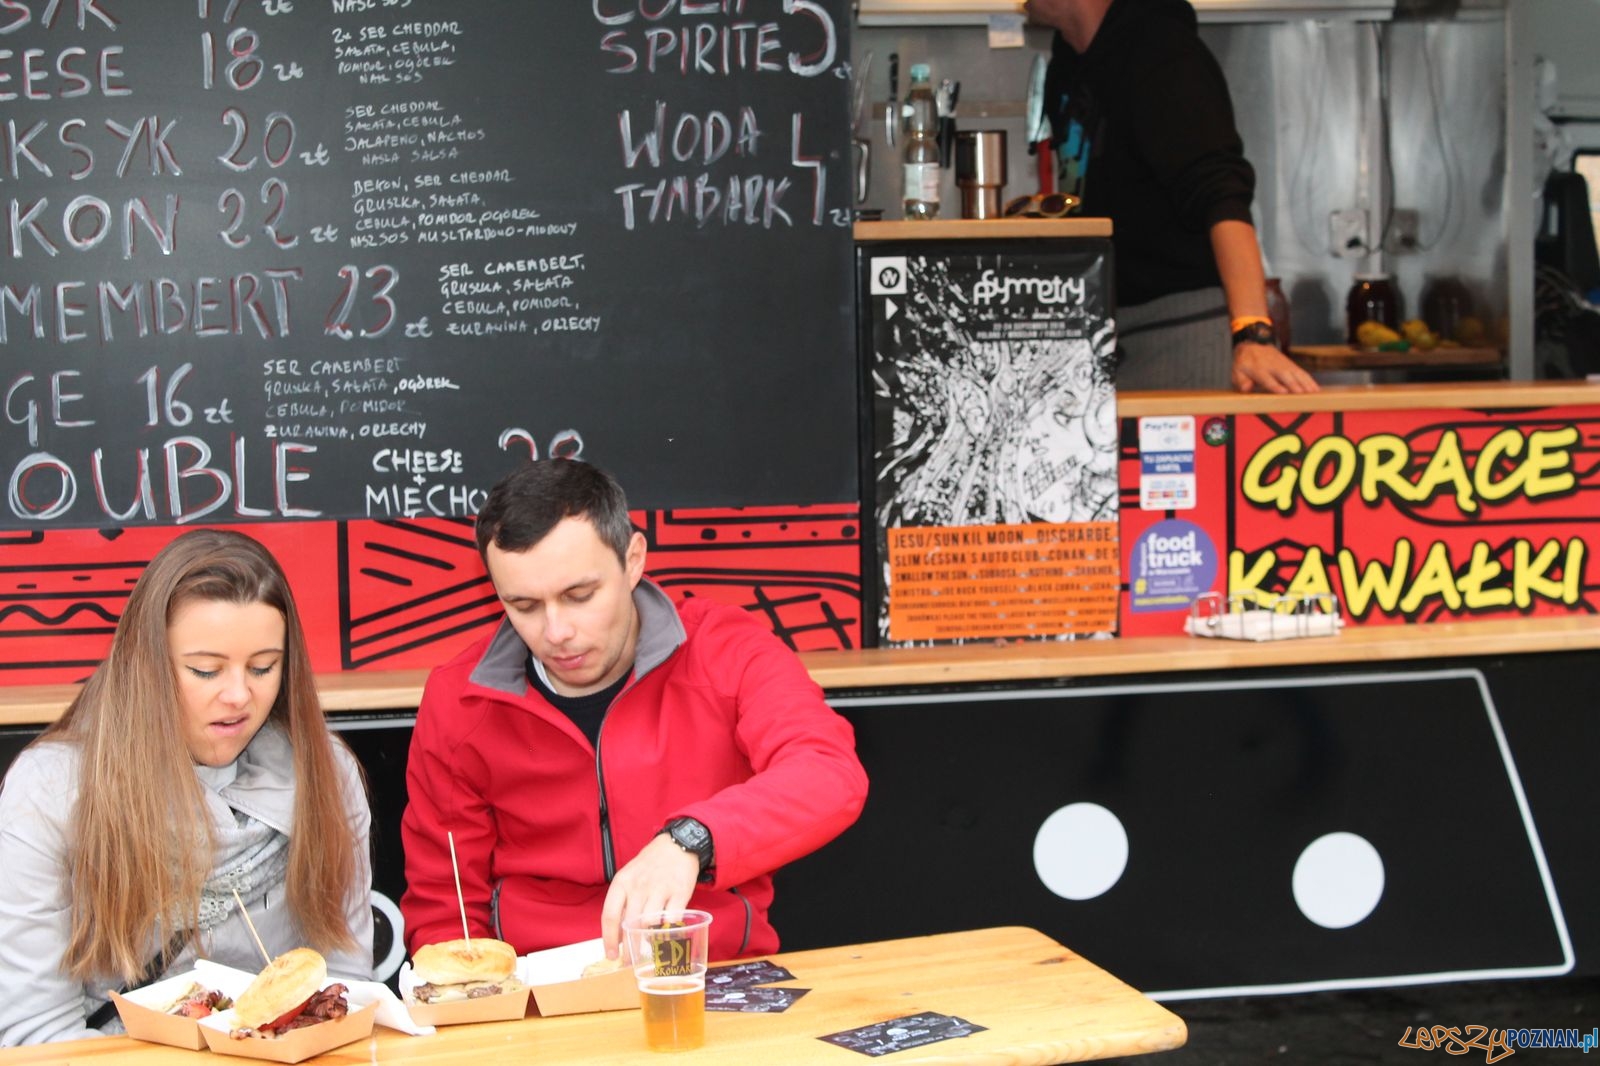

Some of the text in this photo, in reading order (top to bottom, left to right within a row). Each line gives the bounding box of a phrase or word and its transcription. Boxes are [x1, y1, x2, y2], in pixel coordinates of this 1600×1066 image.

[201, 27, 265, 90] 18
[360, 26, 387, 41] SER
[392, 21, 463, 37] CHEDDAR
[600, 23, 783, 75] SPIRITE
[783, 0, 836, 77] 5
[217, 108, 296, 171] 20
[344, 101, 446, 119] SER CHEDDAR
[617, 100, 763, 168] WODA
[414, 174, 443, 188] SER
[449, 169, 516, 184] CHEDDAR
[613, 172, 793, 230] TYMBARK
[9, 194, 179, 261] KON
[217, 177, 299, 249] 22
[438, 262, 474, 282] SER
[0, 267, 303, 345] MEMBERT
[323, 264, 399, 342] 23
[136, 363, 193, 430] 16
[263, 357, 405, 376] SER CAMEMBERT
[8, 432, 322, 524] OUBLE
[372, 449, 463, 474] CHEESE
[1242, 426, 1579, 513] GORĄCE
[987, 530, 1024, 545] MOON
[1147, 530, 1196, 553] food
[1147, 550, 1203, 569] truck
[1228, 537, 1588, 617] KAWAŁKI
